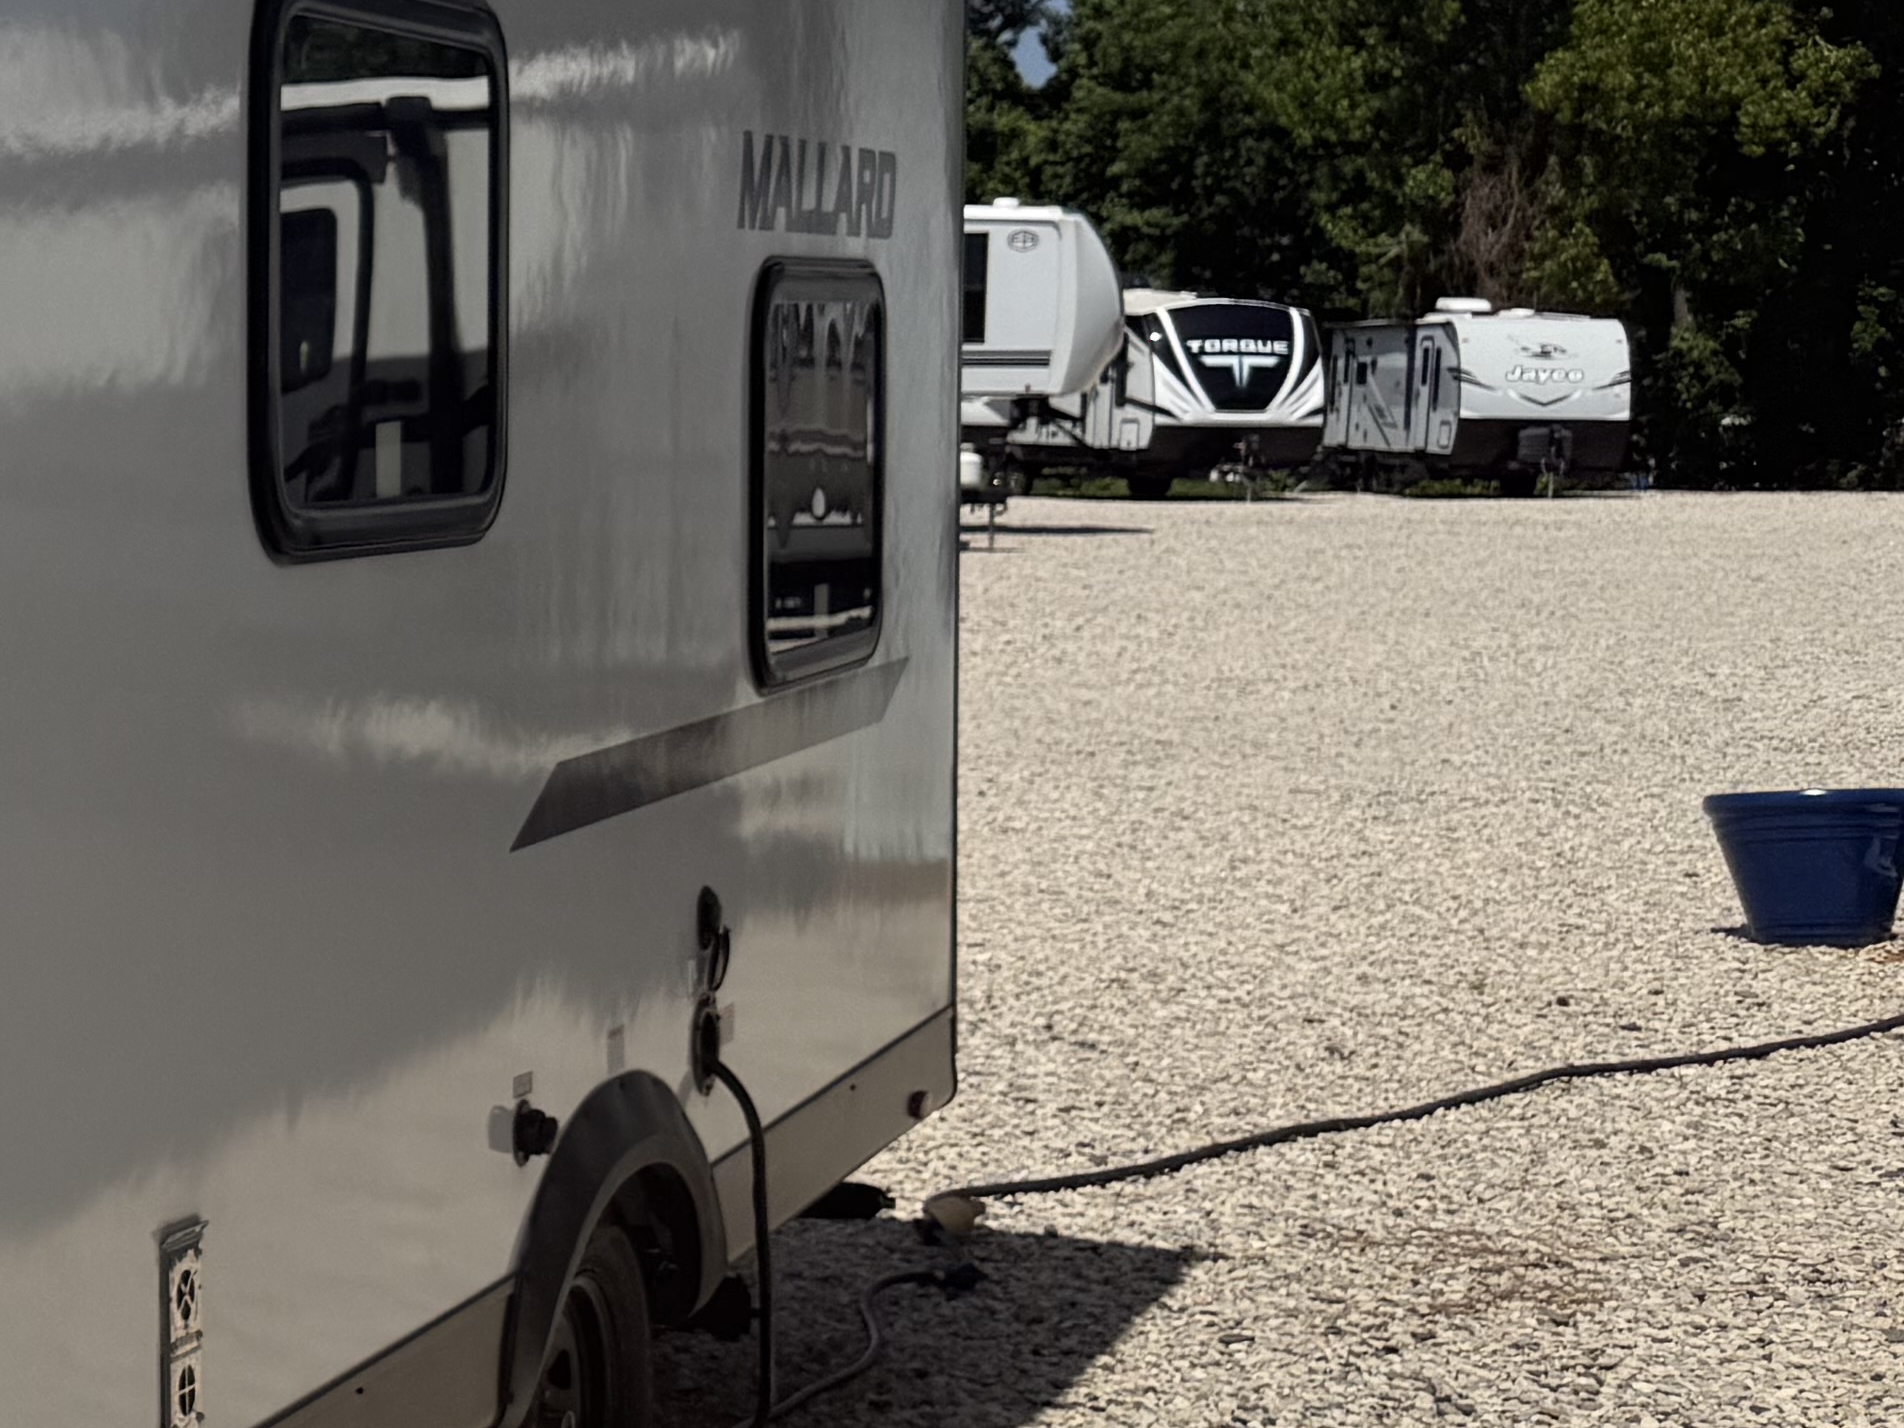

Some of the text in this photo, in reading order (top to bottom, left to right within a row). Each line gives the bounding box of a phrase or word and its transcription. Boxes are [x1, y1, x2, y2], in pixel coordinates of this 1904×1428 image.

[737, 130, 896, 239] MALLARD
[1186, 338, 1289, 355] TORQUE
[1505, 365, 1585, 384] Jayco
